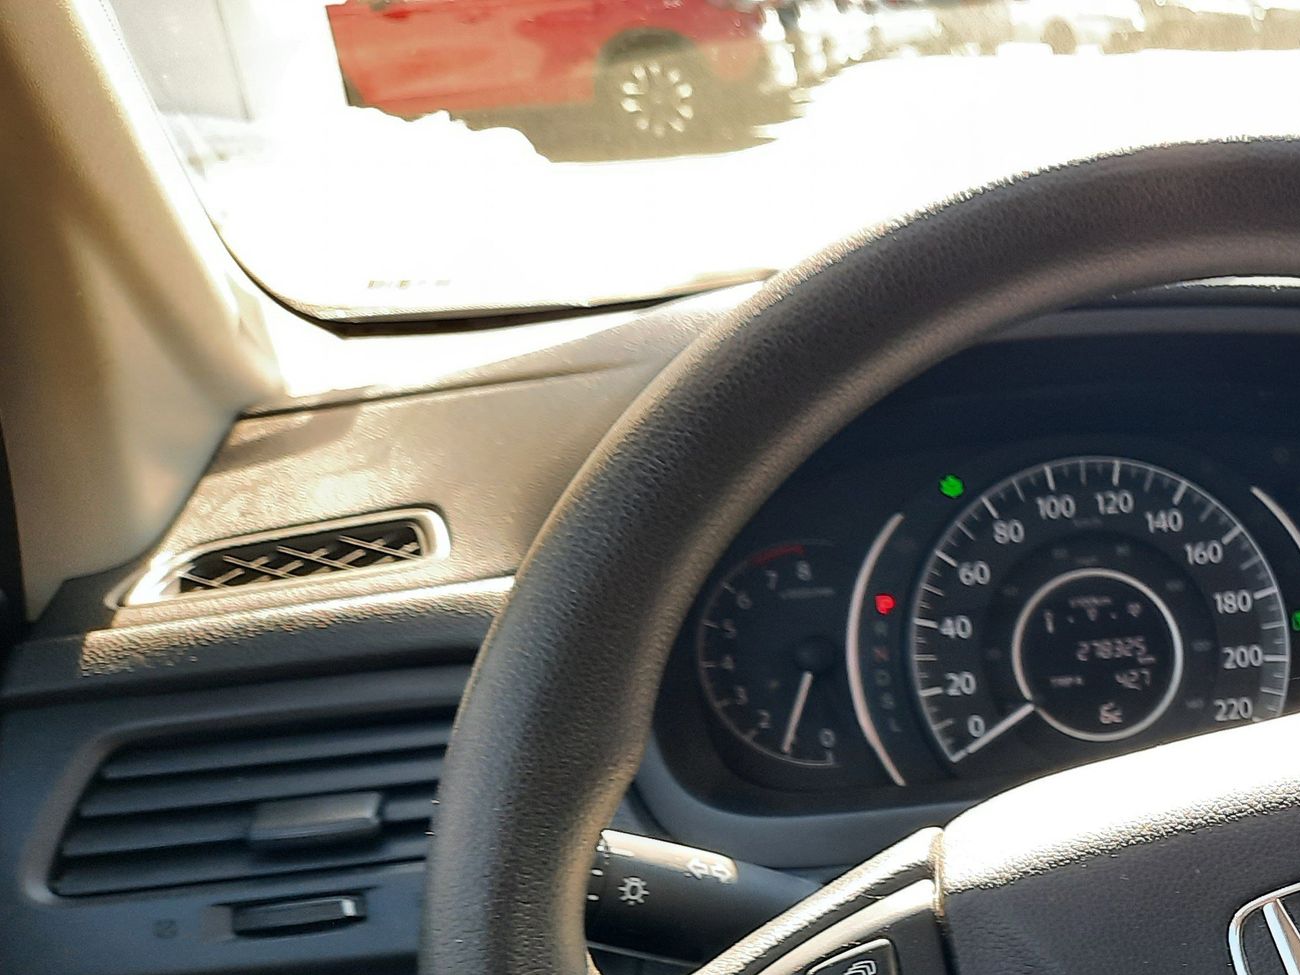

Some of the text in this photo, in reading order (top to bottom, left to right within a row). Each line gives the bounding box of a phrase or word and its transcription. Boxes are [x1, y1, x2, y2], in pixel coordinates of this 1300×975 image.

[1037, 496, 1076, 520] 100
[1095, 490, 1134, 515] 120
[993, 519, 1025, 544] 80
[1145, 510, 1184, 534] 140
[1185, 541, 1224, 566] 160
[958, 560, 991, 586] 60
[1213, 591, 1252, 615] 180
[939, 615, 973, 641] 40
[1222, 645, 1263, 670] 200
[945, 671, 977, 697] 20
[1214, 697, 1253, 722] 220
[967, 714, 986, 739] 0
